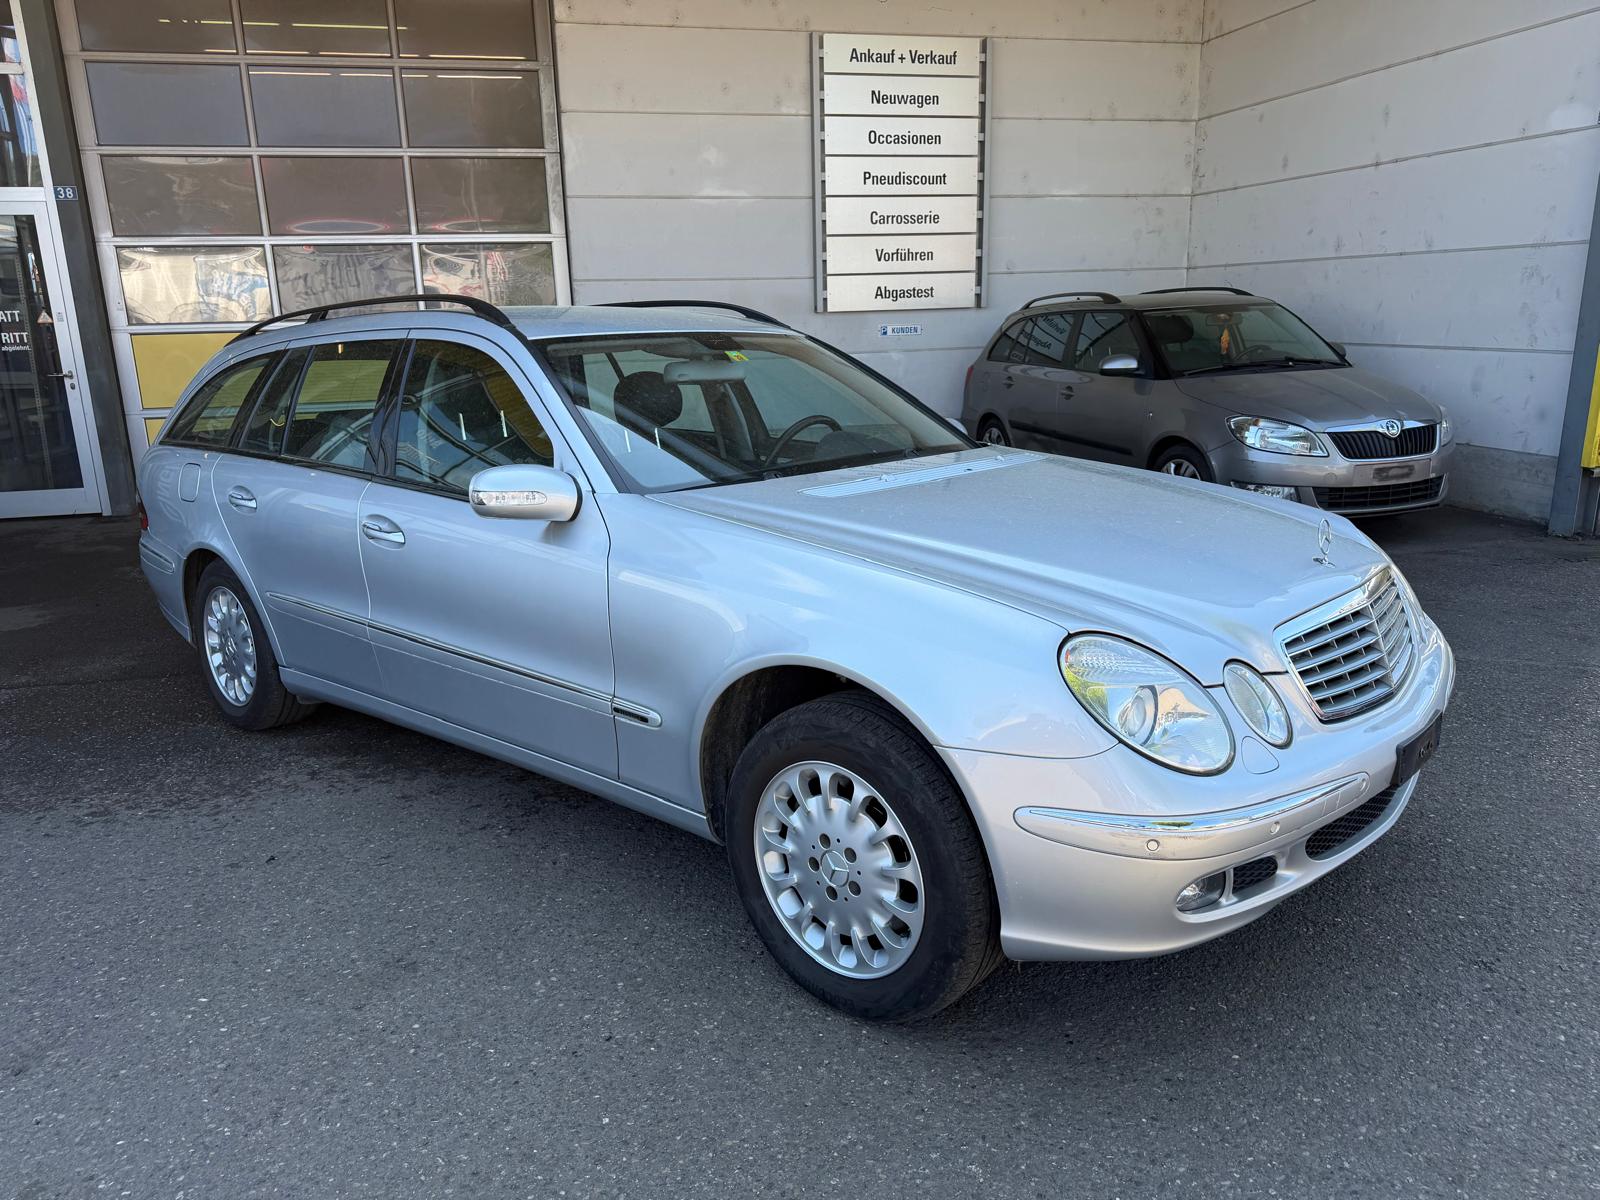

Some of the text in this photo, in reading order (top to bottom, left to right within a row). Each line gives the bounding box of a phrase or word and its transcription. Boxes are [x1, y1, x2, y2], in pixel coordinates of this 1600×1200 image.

[849, 47, 958, 66] Ankauf + Verkauf
[870, 89, 940, 109] Neuwagen
[867, 129, 942, 146] Occasionen
[862, 170, 947, 186] Pneudiscount
[57, 187, 74, 199] 38
[869, 210, 940, 225] Carrosserie
[875, 247, 934, 262] Vorführen
[874, 285, 935, 302] Abgastest
[891, 326, 918, 334] KUNDEN
